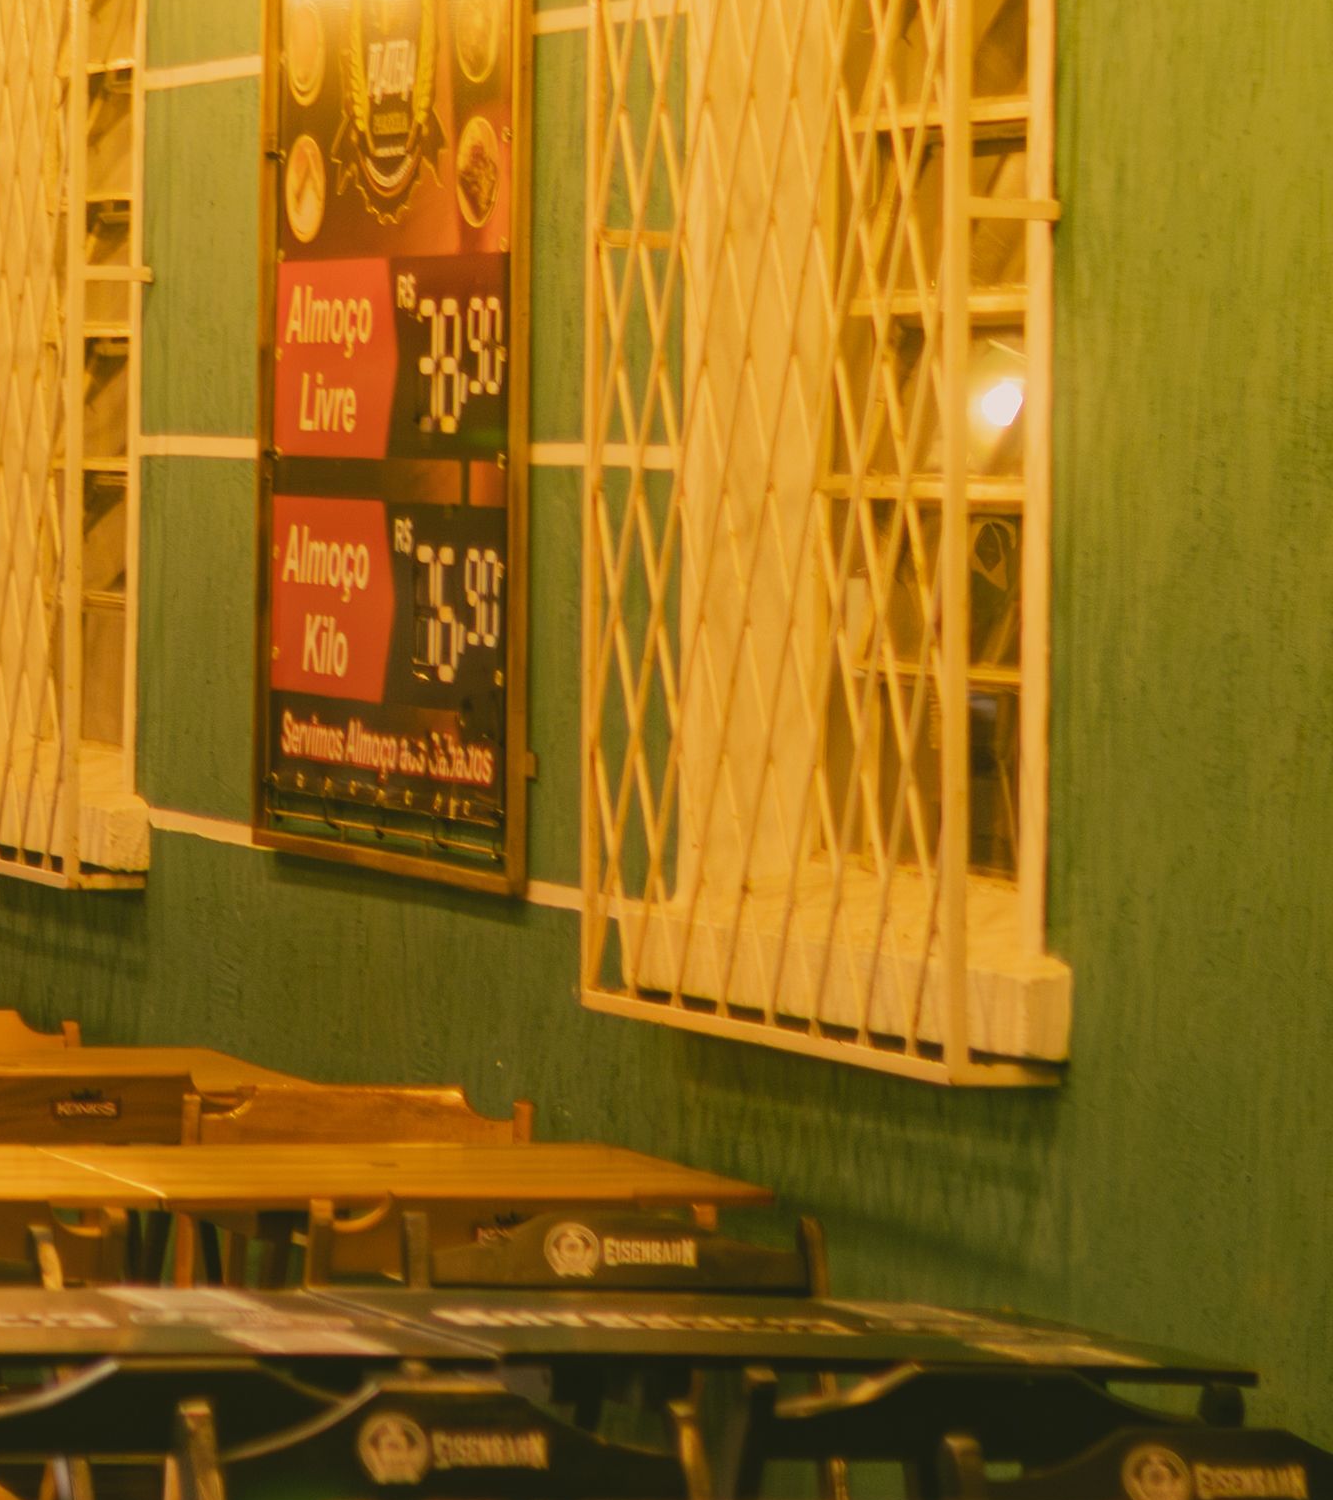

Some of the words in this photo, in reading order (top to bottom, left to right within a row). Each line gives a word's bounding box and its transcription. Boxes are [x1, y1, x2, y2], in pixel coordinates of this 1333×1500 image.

[285, 285, 373, 359] Almoço
[397, 273, 416, 310] R$
[299, 371, 357, 433] Livre
[282, 523, 370, 603] Almoço
[394, 517, 414, 556] R$
[302, 612, 349, 678] Kilo
[281, 709, 345, 764] Servimos
[345, 717, 399, 782] Almoço
[603, 1237, 698, 1268] EISENBAHN
[432, 1430, 549, 1471] EISENBAHN
